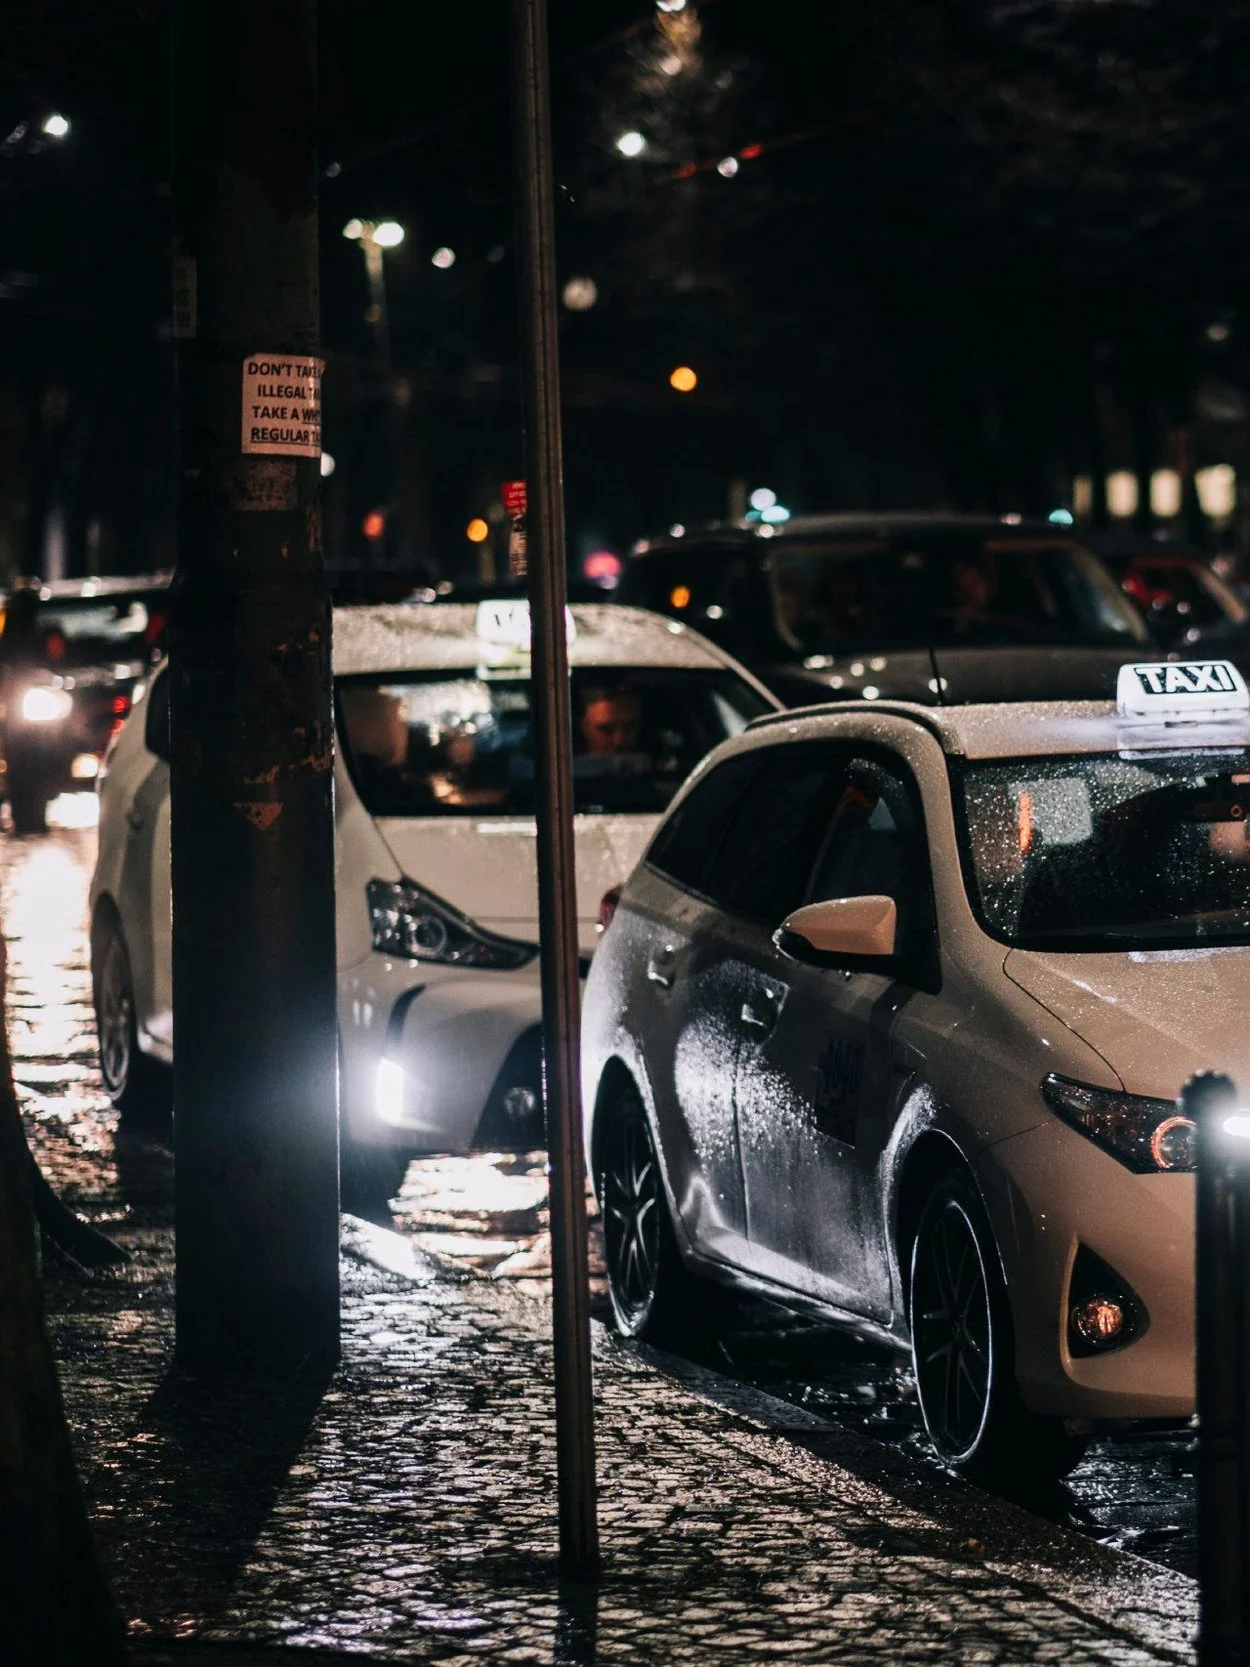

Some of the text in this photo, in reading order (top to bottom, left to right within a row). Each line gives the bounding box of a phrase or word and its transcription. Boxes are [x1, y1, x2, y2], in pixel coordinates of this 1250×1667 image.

[248, 362, 292, 376] DON'T
[258, 385, 306, 399] ILLEGAL
[252, 406, 287, 419] TAKE
[291, 408, 299, 420] A
[251, 427, 309, 442] REGULAR
[1135, 665, 1236, 694] TAXI
